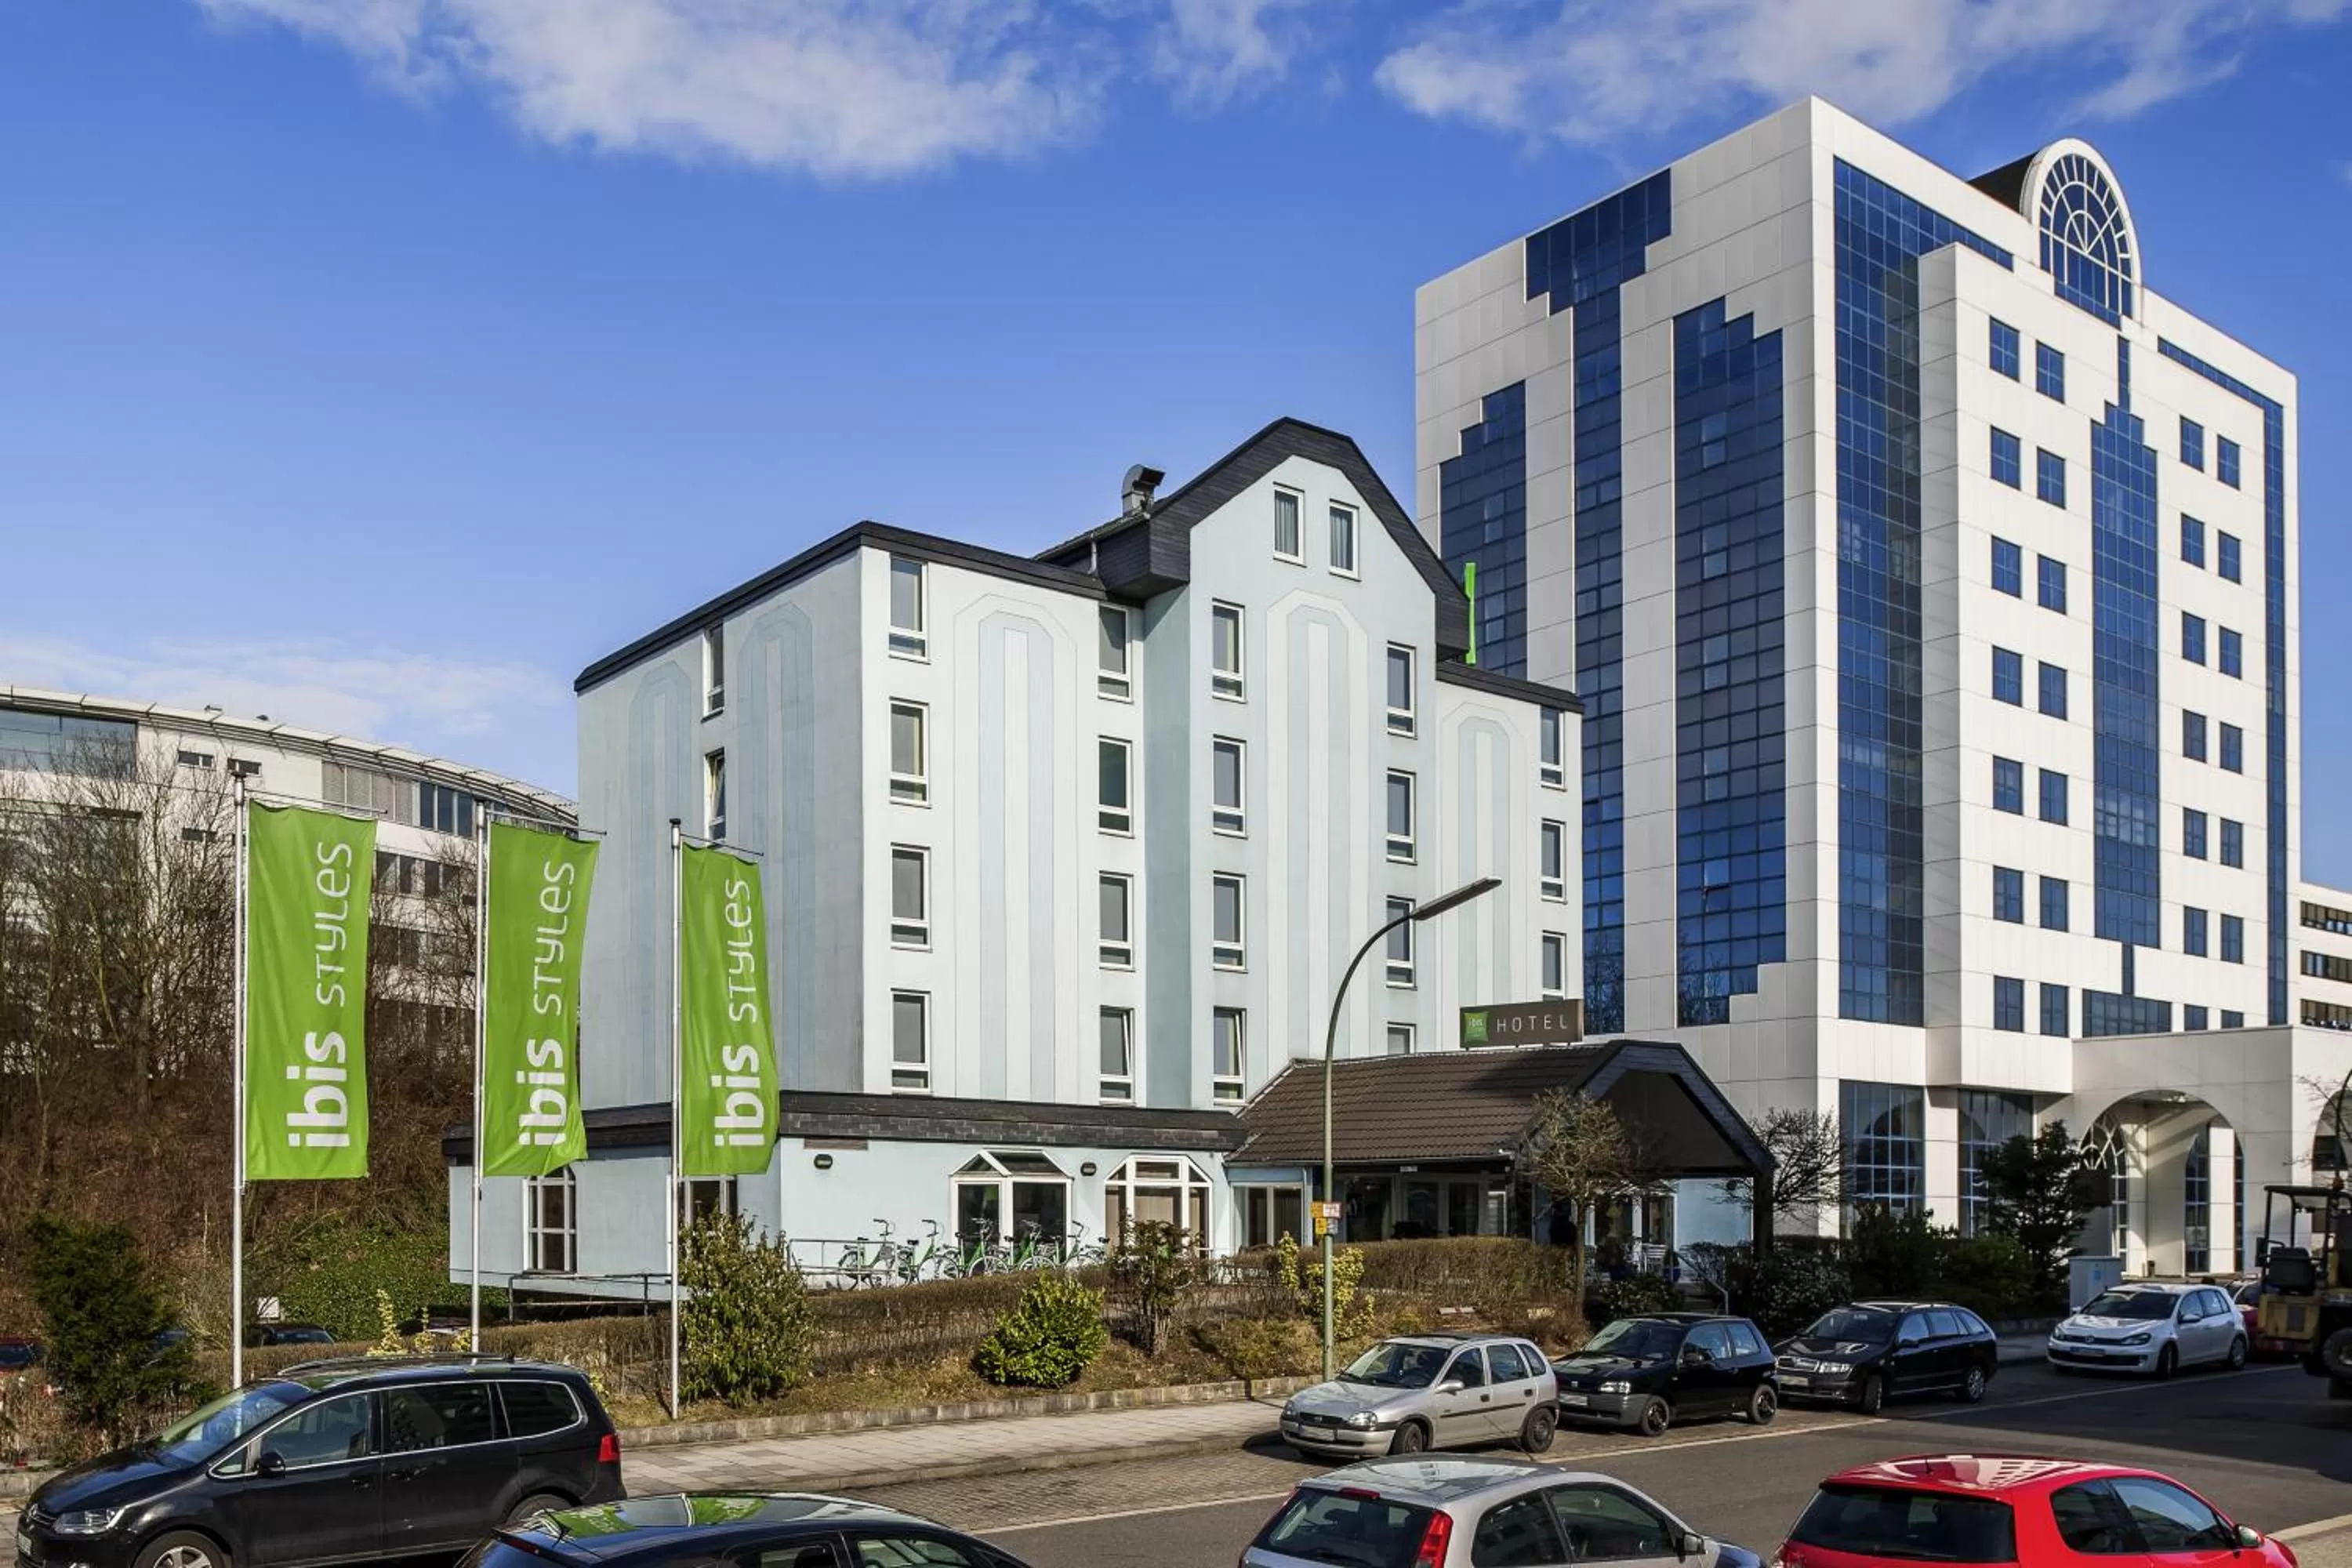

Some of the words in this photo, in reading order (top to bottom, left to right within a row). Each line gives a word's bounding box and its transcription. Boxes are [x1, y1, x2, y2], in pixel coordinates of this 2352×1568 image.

[1497, 1014, 1568, 1033] HOTEL
[286, 1031, 350, 1148] ibis
[516, 1039, 568, 1146] ibis
[710, 1044, 764, 1147] ibis
